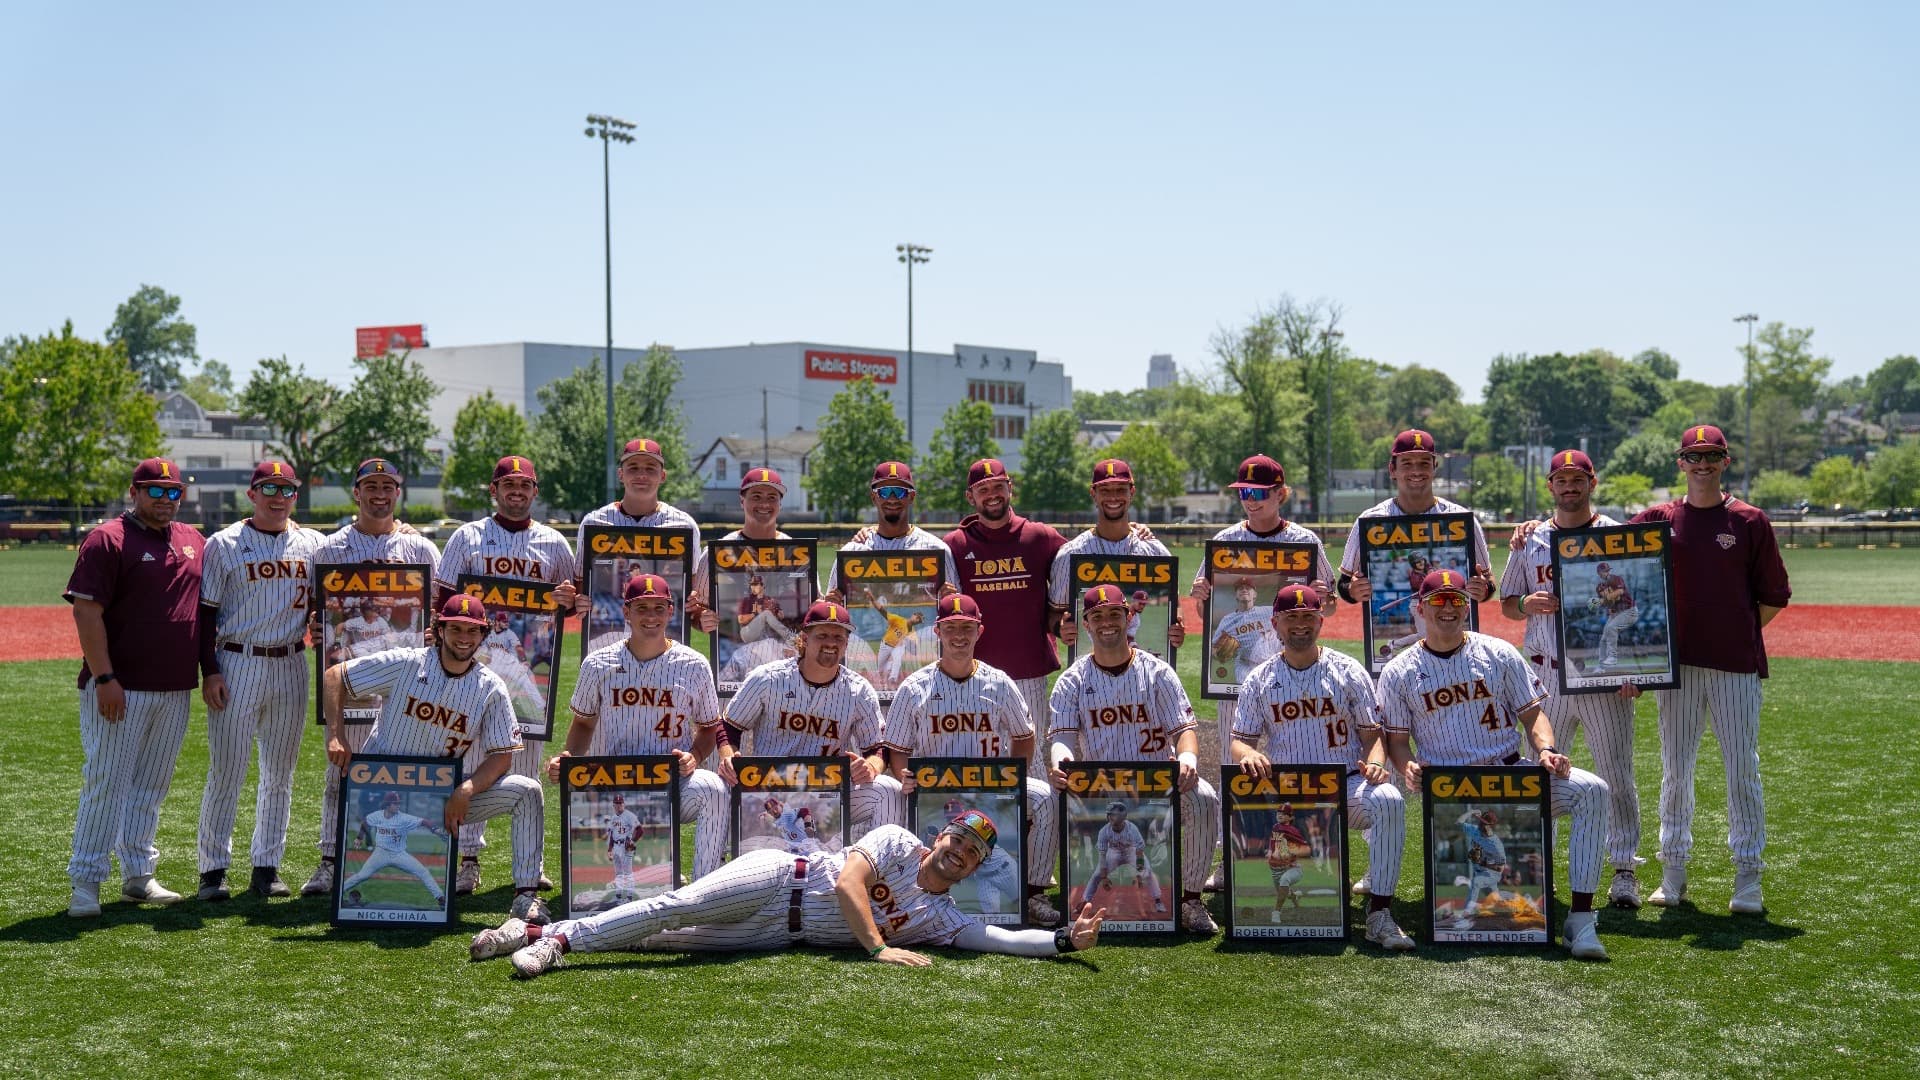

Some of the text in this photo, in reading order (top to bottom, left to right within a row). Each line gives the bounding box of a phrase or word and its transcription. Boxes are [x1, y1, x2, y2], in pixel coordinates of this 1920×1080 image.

[811, 357, 894, 380] Public Storage
[1366, 521, 1467, 546] GAELS
[1558, 530, 1664, 559] GAELS
[591, 534, 686, 556] GAELS
[483, 557, 543, 579] IONA
[715, 547, 810, 568] GAELS
[844, 557, 939, 578] GAELS
[975, 557, 1027, 576] IONA
[1212, 549, 1311, 571] GAELS
[246, 561, 308, 582] IONA
[323, 570, 424, 592] GAELS
[1077, 562, 1172, 583] GAELS
[463, 583, 559, 611] GAELS
[976, 581, 1028, 592] BASEBALL
[611, 687, 674, 707] IONA
[1226, 686, 1239, 694] SE
[1421, 678, 1494, 713] IONA
[403, 696, 469, 734] IONA
[1089, 704, 1150, 729] IONA
[1271, 698, 1337, 723] IONA
[1481, 702, 1513, 731] 41
[655, 713, 685, 738] 43
[778, 711, 839, 739] IONA
[930, 713, 993, 734] IONA
[1325, 719, 1349, 749] 19
[445, 737, 473, 758] 37
[980, 736, 1000, 757] 15
[1139, 728, 1166, 753] 25
[350, 763, 455, 787] GAELS
[568, 763, 671, 787] GAELS
[739, 765, 843, 787] GAELS
[917, 766, 1019, 788] GAELS
[1067, 770, 1173, 792] GAELS
[1230, 773, 1340, 796] GAELS
[1431, 775, 1542, 798] GAELS
[357, 911, 428, 921] NICK CHIAIA
[868, 882, 910, 933] ONA
[1100, 922, 1165, 931] HONY FEBO
[1235, 928, 1340, 937] ROBERT LASBURY
[1446, 932, 1535, 942] TYLER LENDER
